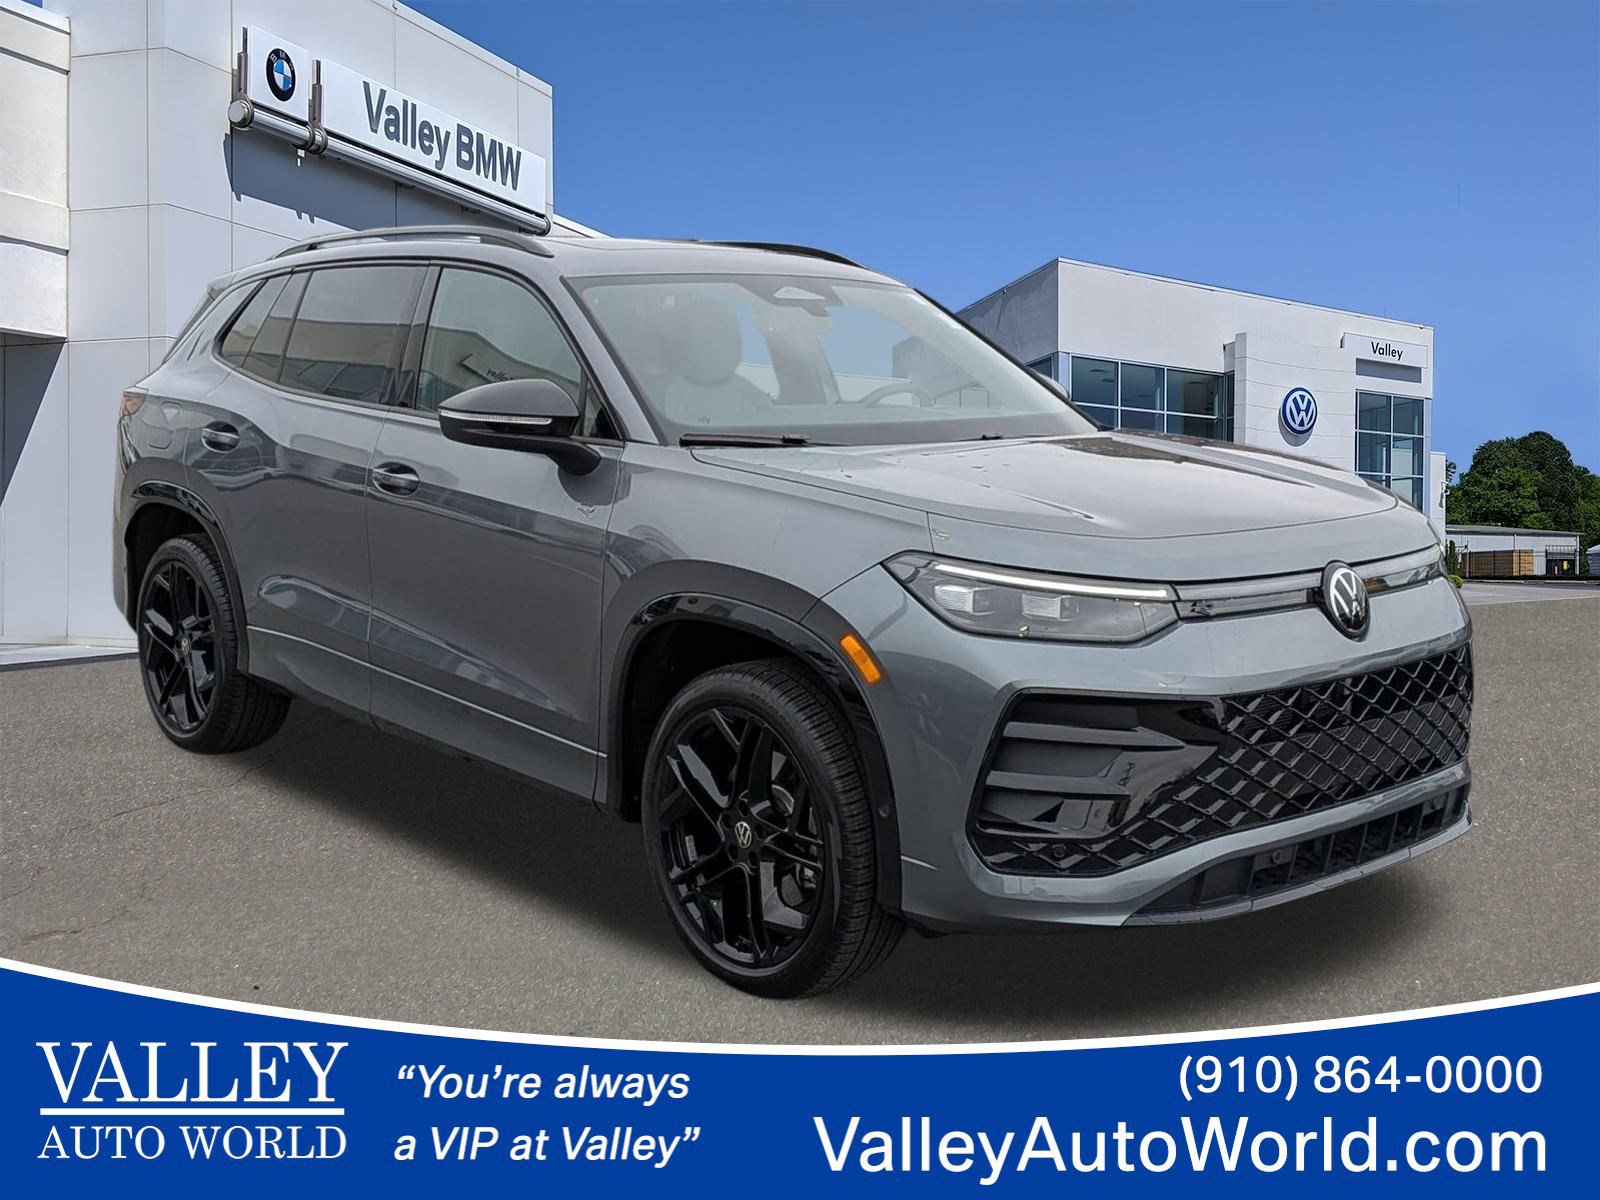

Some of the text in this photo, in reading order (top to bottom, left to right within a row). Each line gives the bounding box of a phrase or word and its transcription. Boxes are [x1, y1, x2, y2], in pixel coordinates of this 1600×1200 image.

[362, 80, 522, 191] Valley BMW
[1371, 341, 1403, 361] Valley
